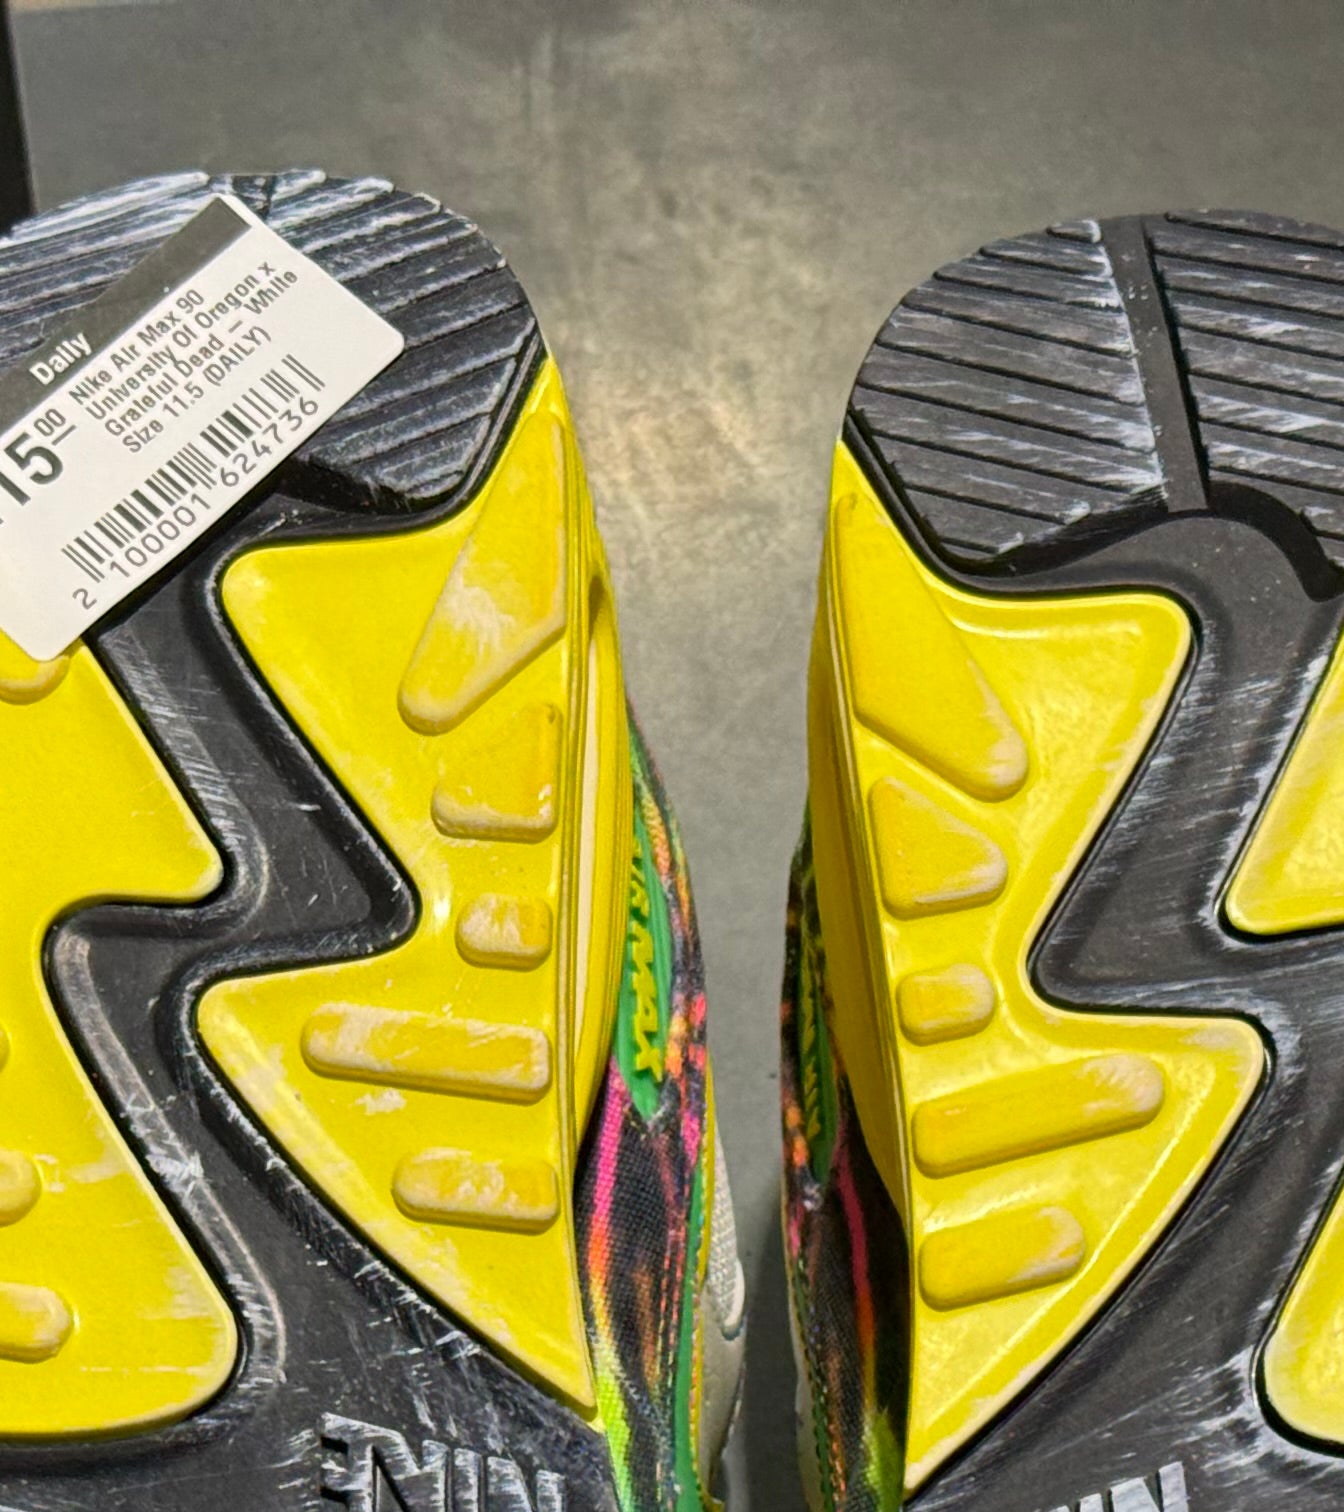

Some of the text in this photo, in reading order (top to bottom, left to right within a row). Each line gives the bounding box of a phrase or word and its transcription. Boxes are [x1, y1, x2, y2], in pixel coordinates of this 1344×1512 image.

[29, 333, 91, 384] Daily
[69, 290, 204, 405] Nike Air Max 90
[85, 262, 275, 420] University Of Oregon x
[105, 372, 178, 436] Grateful
[174, 333, 224, 378] Dead
[243, 272, 297, 314] White
[123, 326, 271, 452] Size 11.5 (DAILY)
[72, 397, 318, 610] 2 100001 624736
